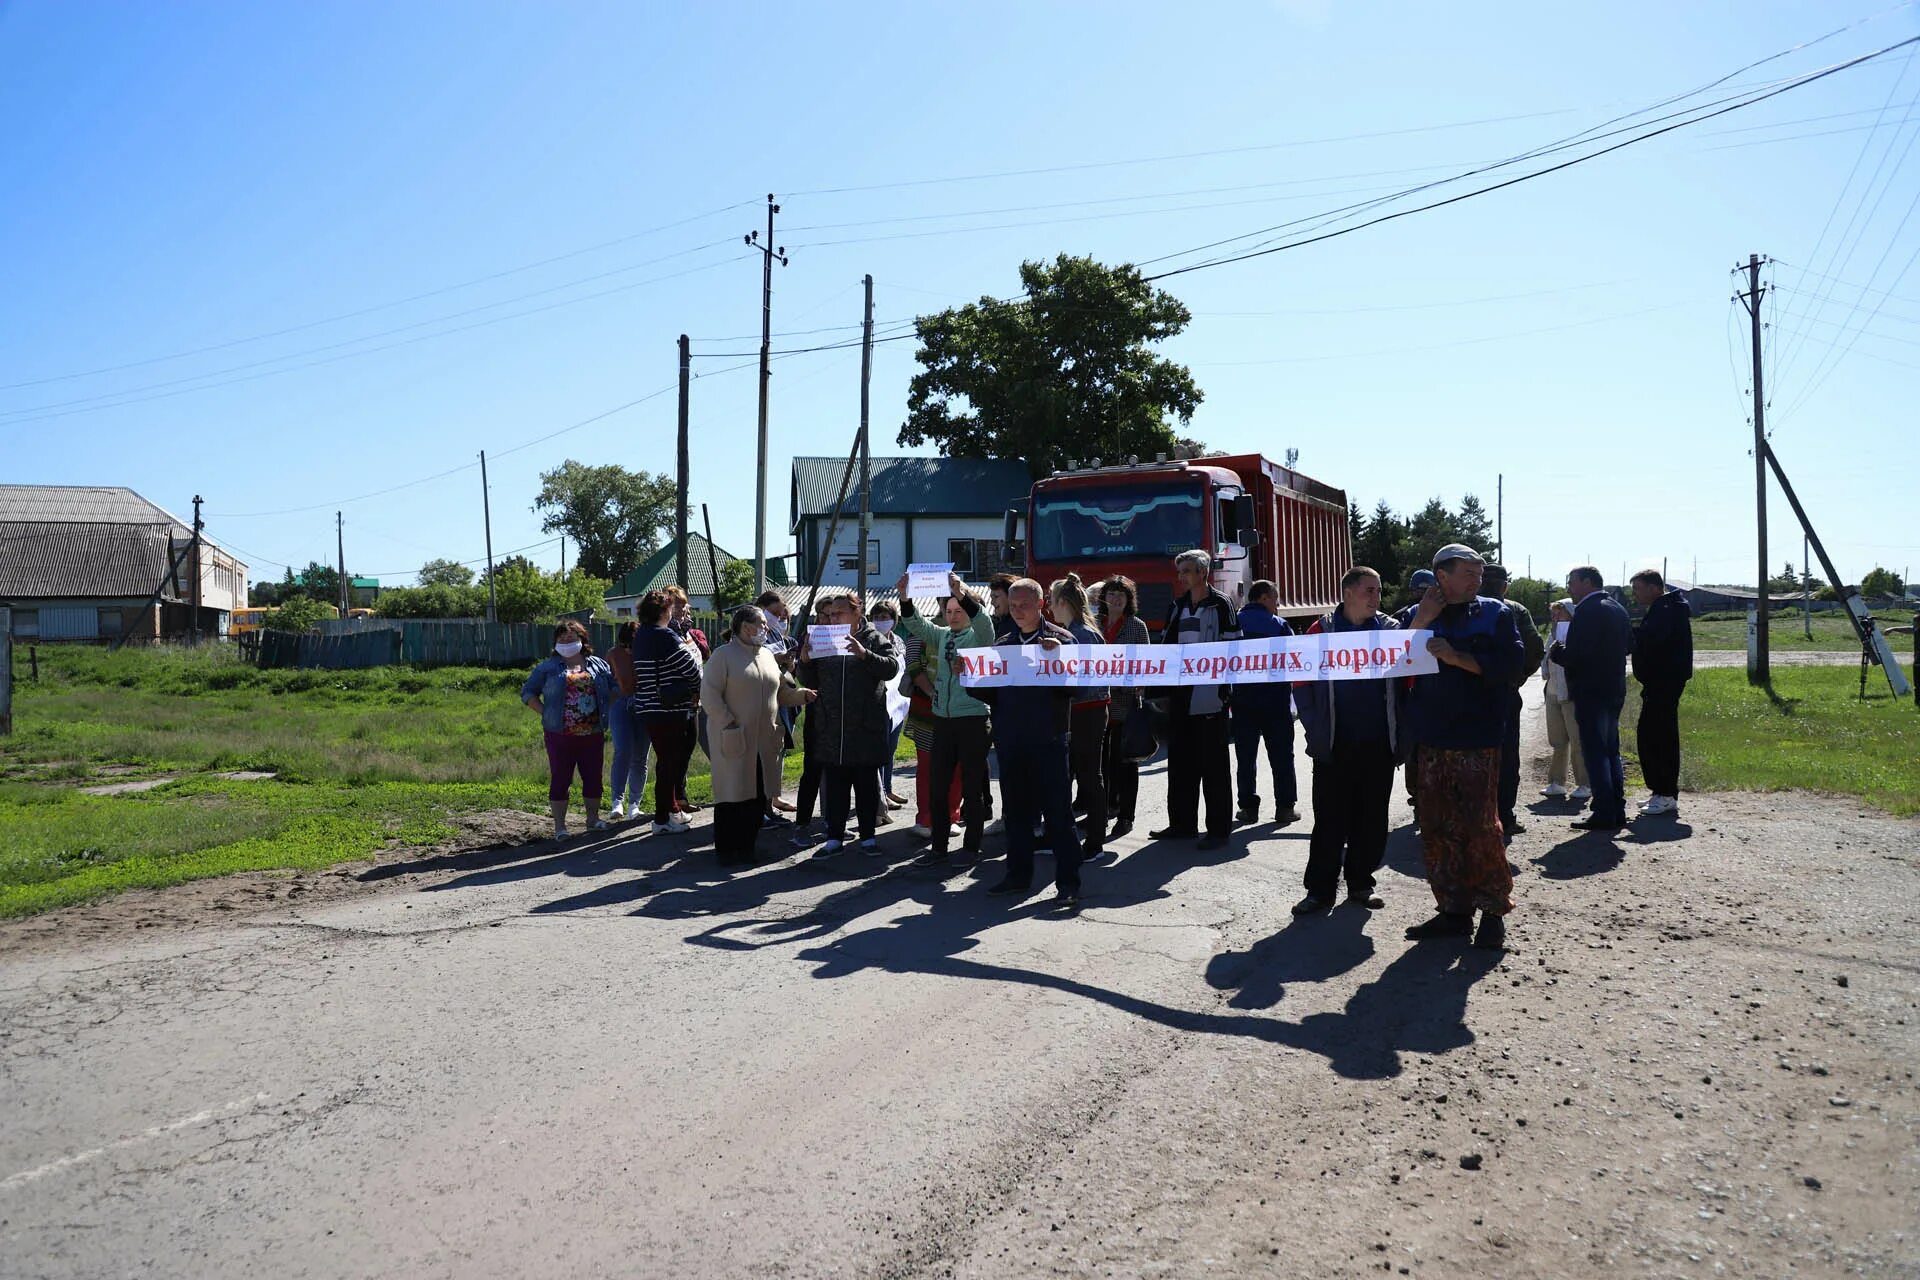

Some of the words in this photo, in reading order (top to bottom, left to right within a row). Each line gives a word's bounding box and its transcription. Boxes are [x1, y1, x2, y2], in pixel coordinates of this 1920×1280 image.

[1107, 545, 1134, 553] MAN
[962, 655, 1009, 678] Мы
[1036, 653, 1167, 679] достойны
[1182, 651, 1303, 679] хороших
[1319, 640, 1412, 674] дорог!
